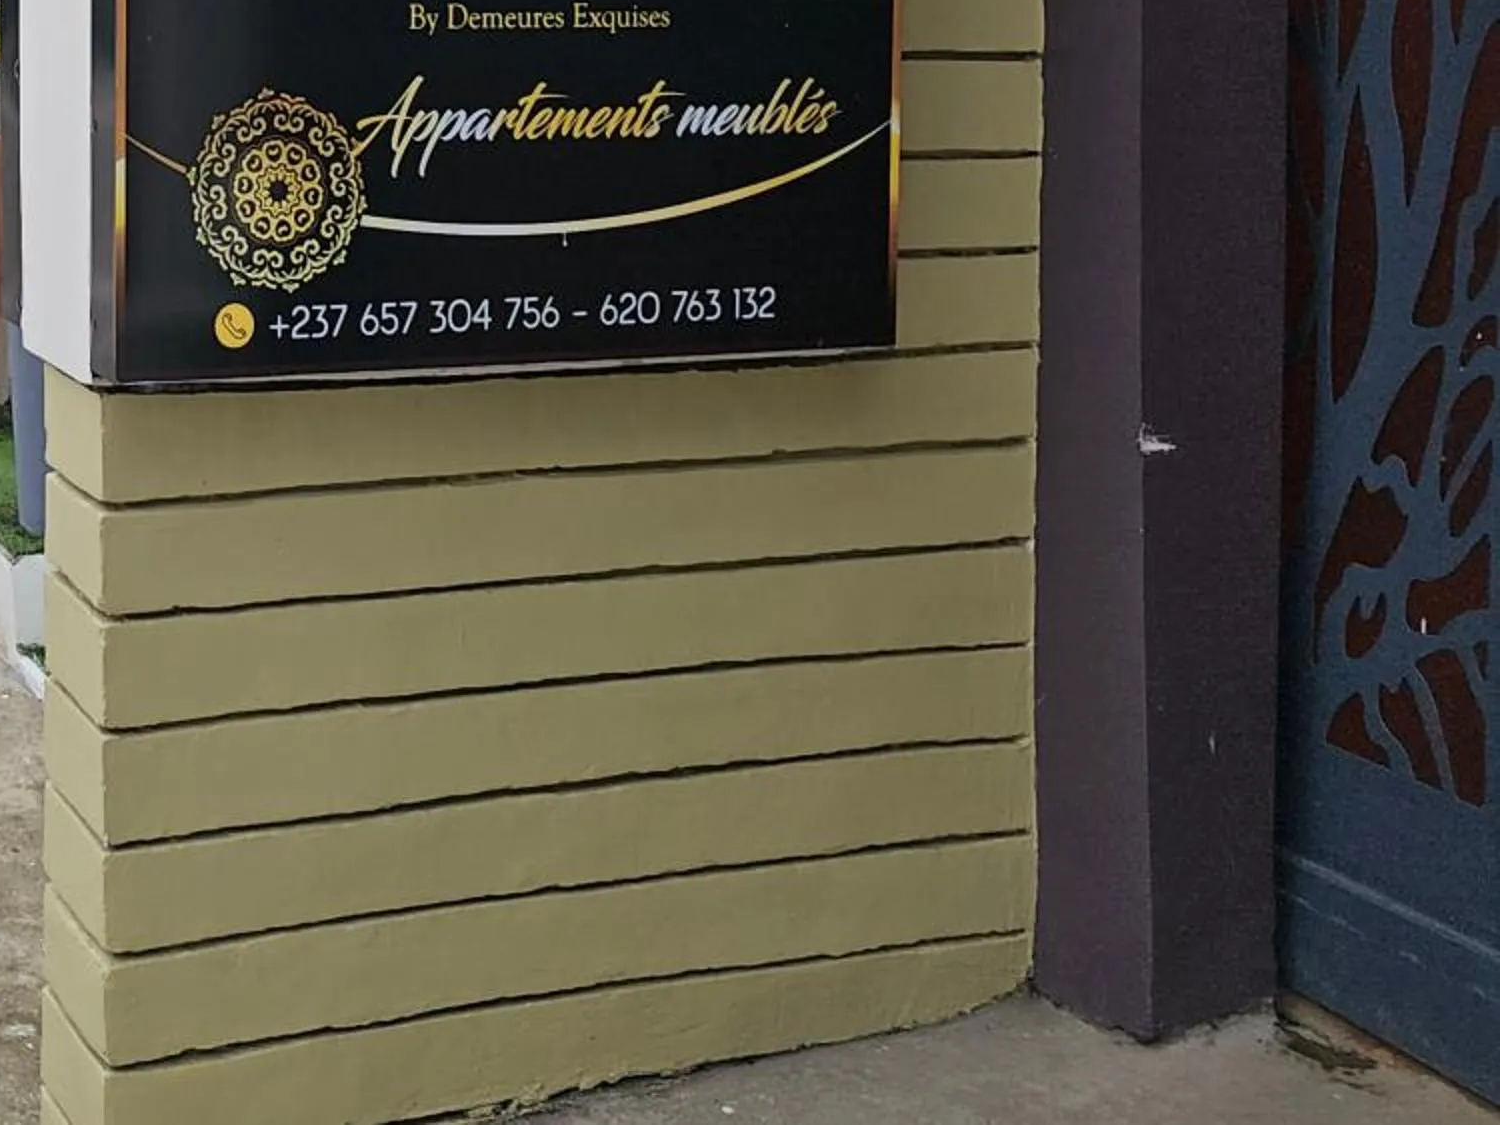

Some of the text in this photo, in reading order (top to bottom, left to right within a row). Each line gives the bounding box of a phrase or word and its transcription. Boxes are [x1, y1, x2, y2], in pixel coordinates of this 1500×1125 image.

[409, 2, 671, 36] By Demeures Exquises
[356, 75, 842, 178] Appartements meublés
[269, 303, 349, 340] +237
[359, 300, 418, 336] 657
[429, 298, 493, 334] 304
[504, 295, 560, 330] 756
[599, 290, 661, 326] 620
[671, 288, 722, 323] 763
[733, 286, 776, 320] 132
